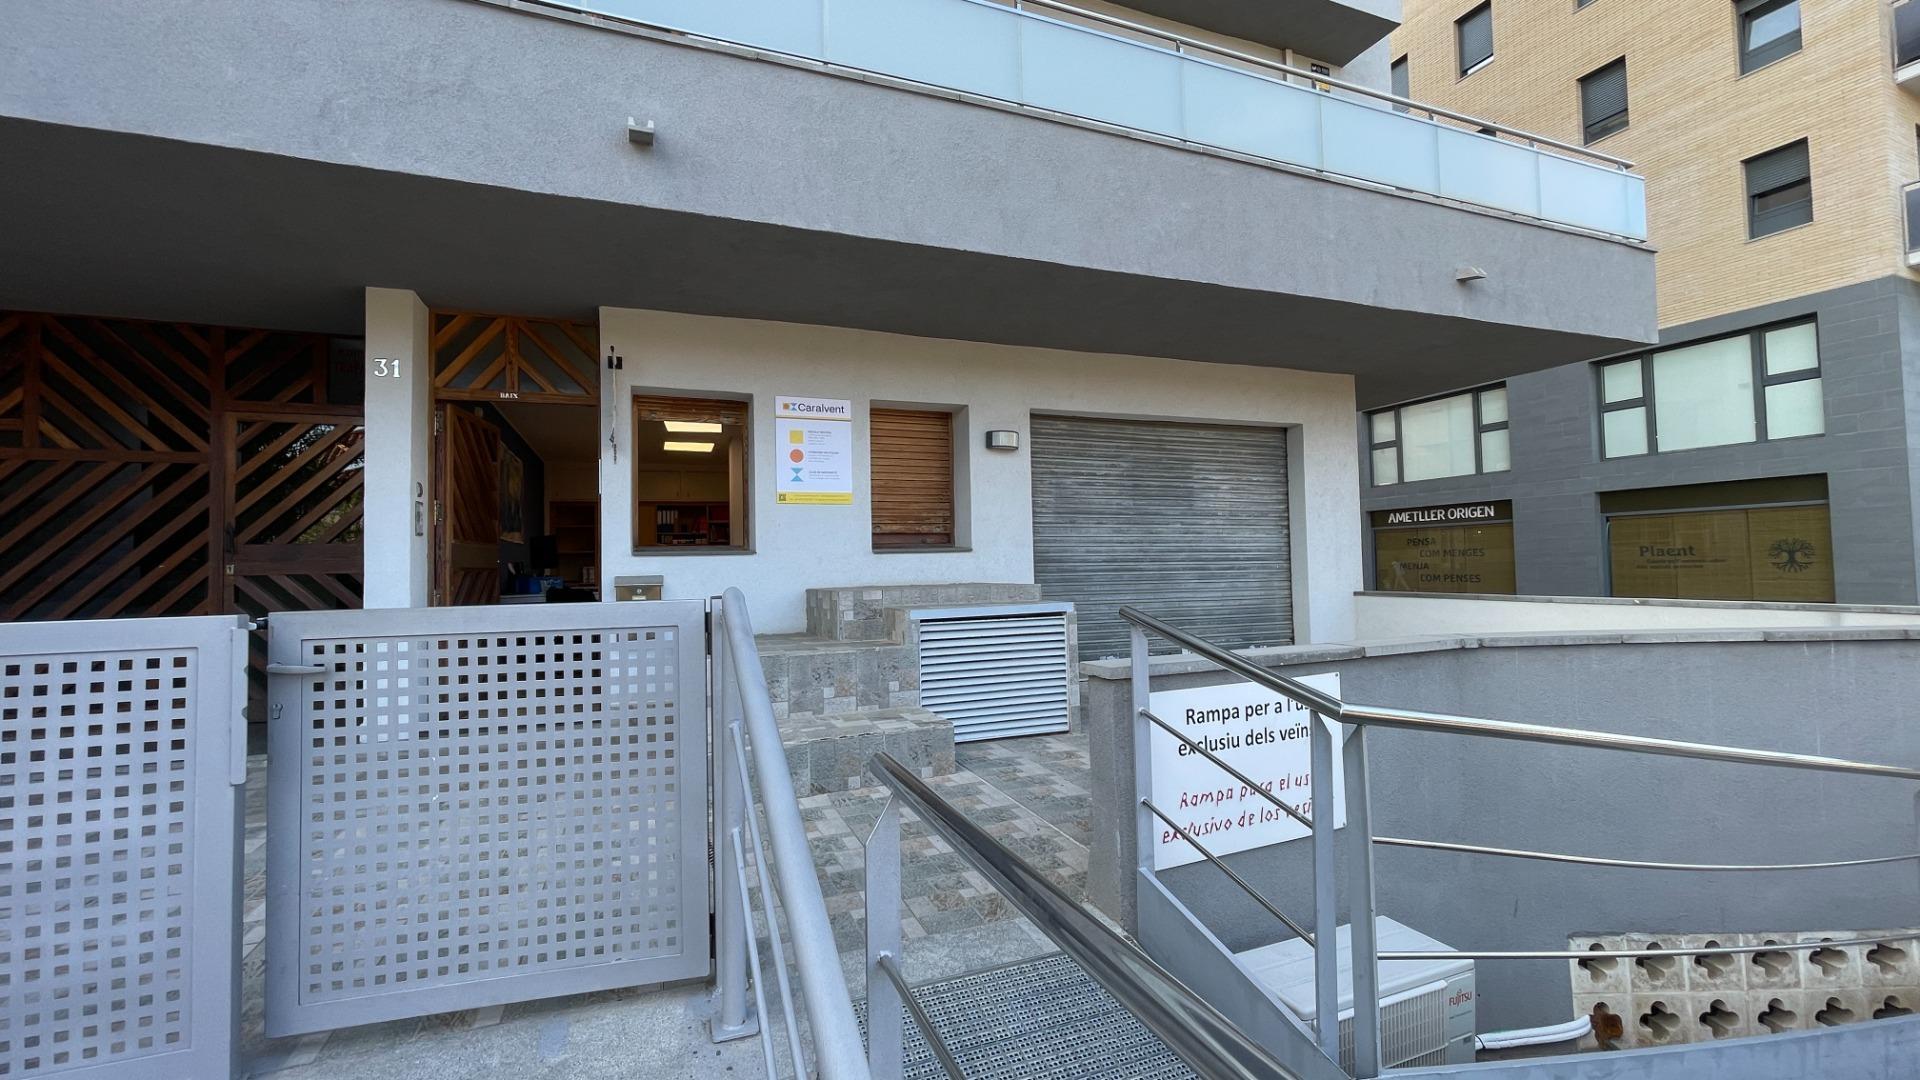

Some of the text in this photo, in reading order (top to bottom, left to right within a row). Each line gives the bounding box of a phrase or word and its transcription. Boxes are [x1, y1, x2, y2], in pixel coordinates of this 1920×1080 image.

[374, 358, 401, 378] 31
[797, 403, 845, 414] Caralvent
[1388, 505, 1495, 524] AMETLLER ORIGEN
[1407, 537, 1436, 547] PENSA
[1420, 547, 1486, 558] COM MENGES
[1420, 573, 1481, 583] COM PENSES
[1186, 706, 1240, 726] Rampa
[1245, 702, 1270, 721] per
[1274, 701, 1283, 714] a
[1245, 727, 1275, 746] dels
[1280, 723, 1309, 741] veïn
[1180, 787, 1234, 810] Rampa
[1280, 773, 1290, 791] el
[1295, 773, 1310, 787] us
[1237, 812, 1255, 829] de
[1260, 806, 1280, 824] los
[1448, 991, 1473, 1007] FUJITSU
